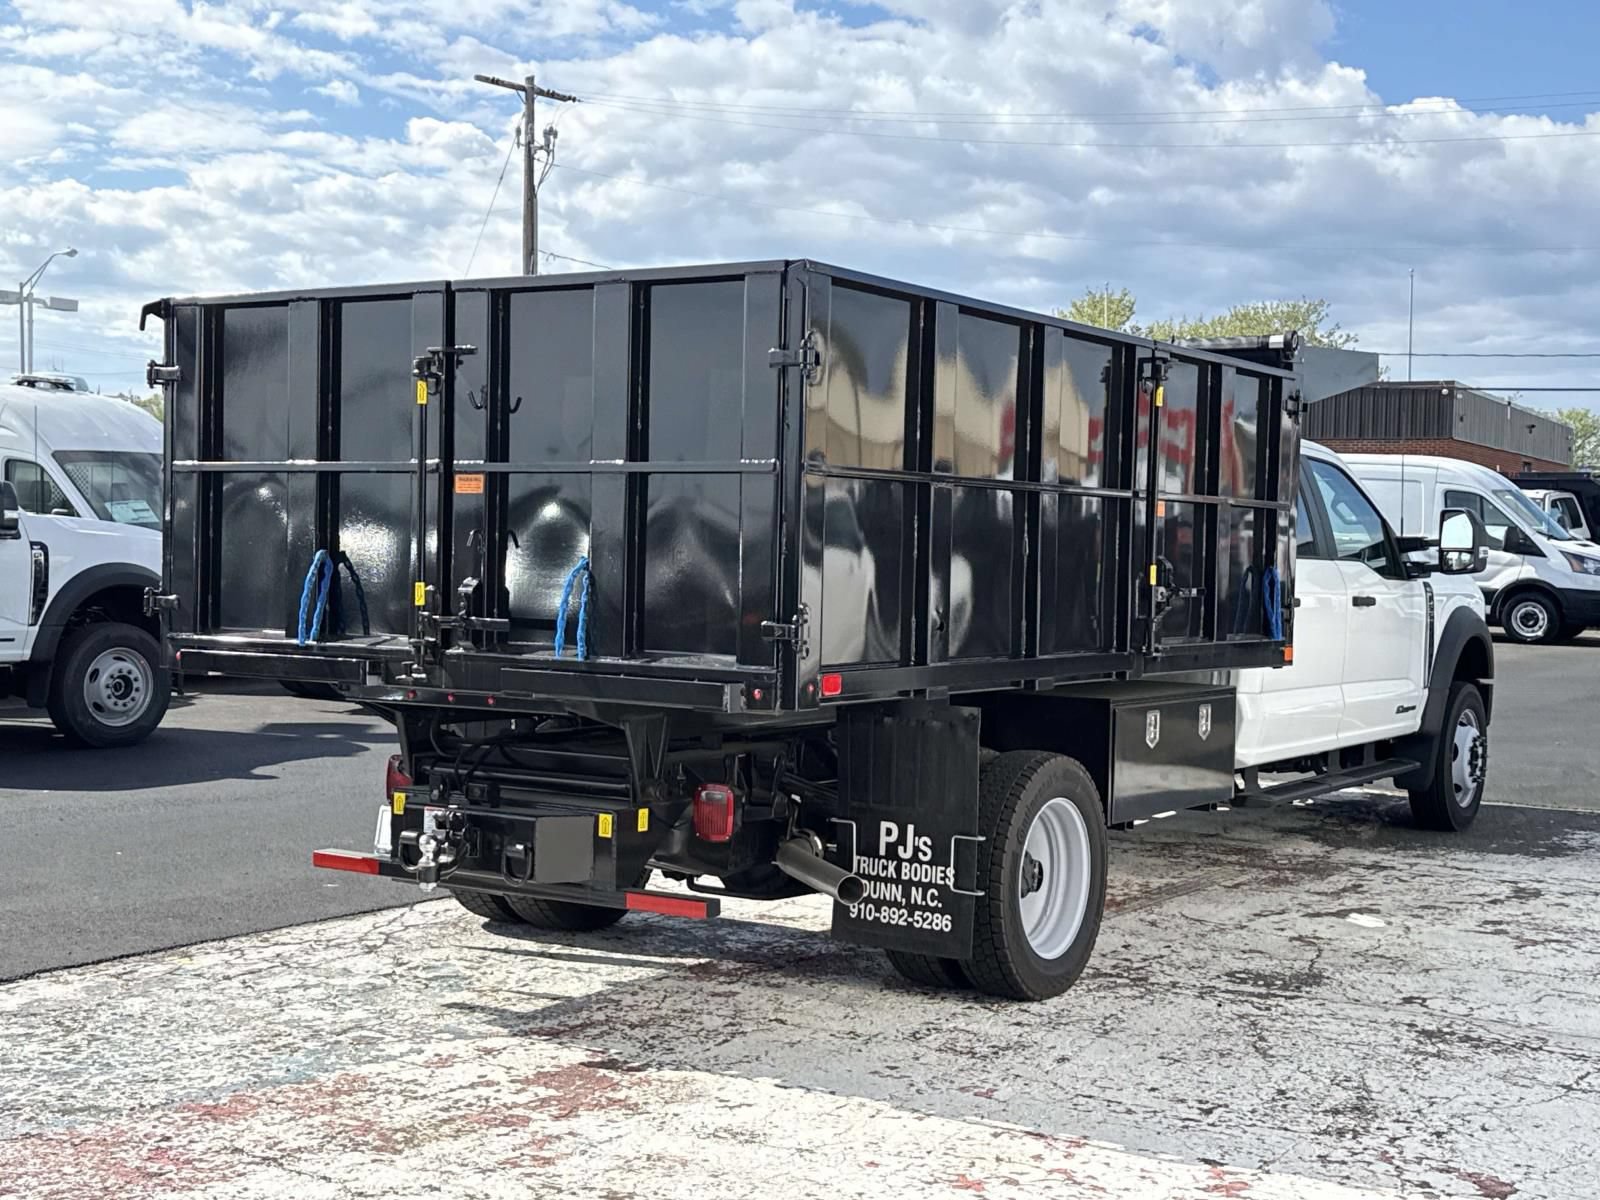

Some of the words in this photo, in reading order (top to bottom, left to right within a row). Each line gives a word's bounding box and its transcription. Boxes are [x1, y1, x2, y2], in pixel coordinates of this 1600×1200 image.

[879, 820, 933, 862] PJ's
[855, 855, 898, 879] TRUCK
[901, 861, 956, 886] BODIES
[862, 879, 906, 907] DUNN,
[910, 886, 943, 908] N.C.
[849, 902, 953, 933] 910-892-5286
